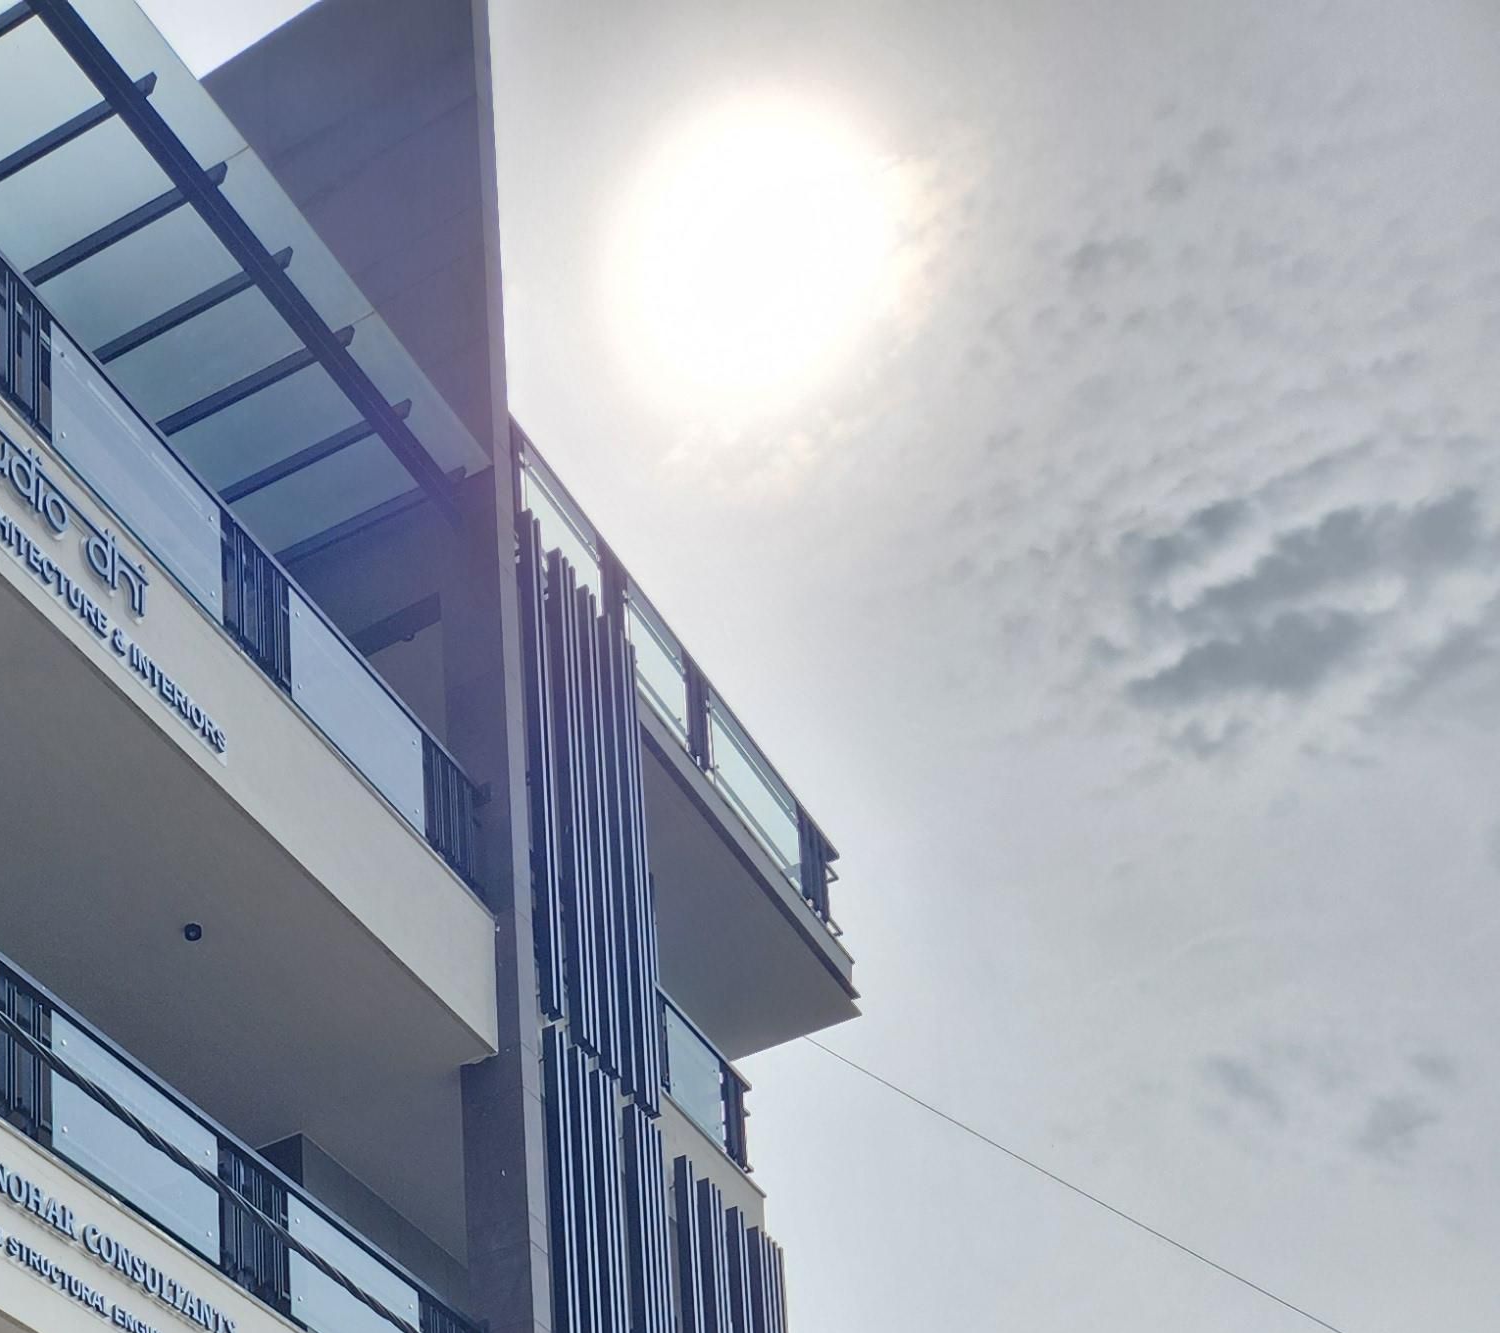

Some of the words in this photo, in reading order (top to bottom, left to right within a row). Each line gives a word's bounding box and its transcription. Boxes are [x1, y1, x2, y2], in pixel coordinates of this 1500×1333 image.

[111, 628, 127, 657] &
[129, 642, 228, 753] INTERIORS
[6, 1235, 112, 1318] STRUCTURAL
